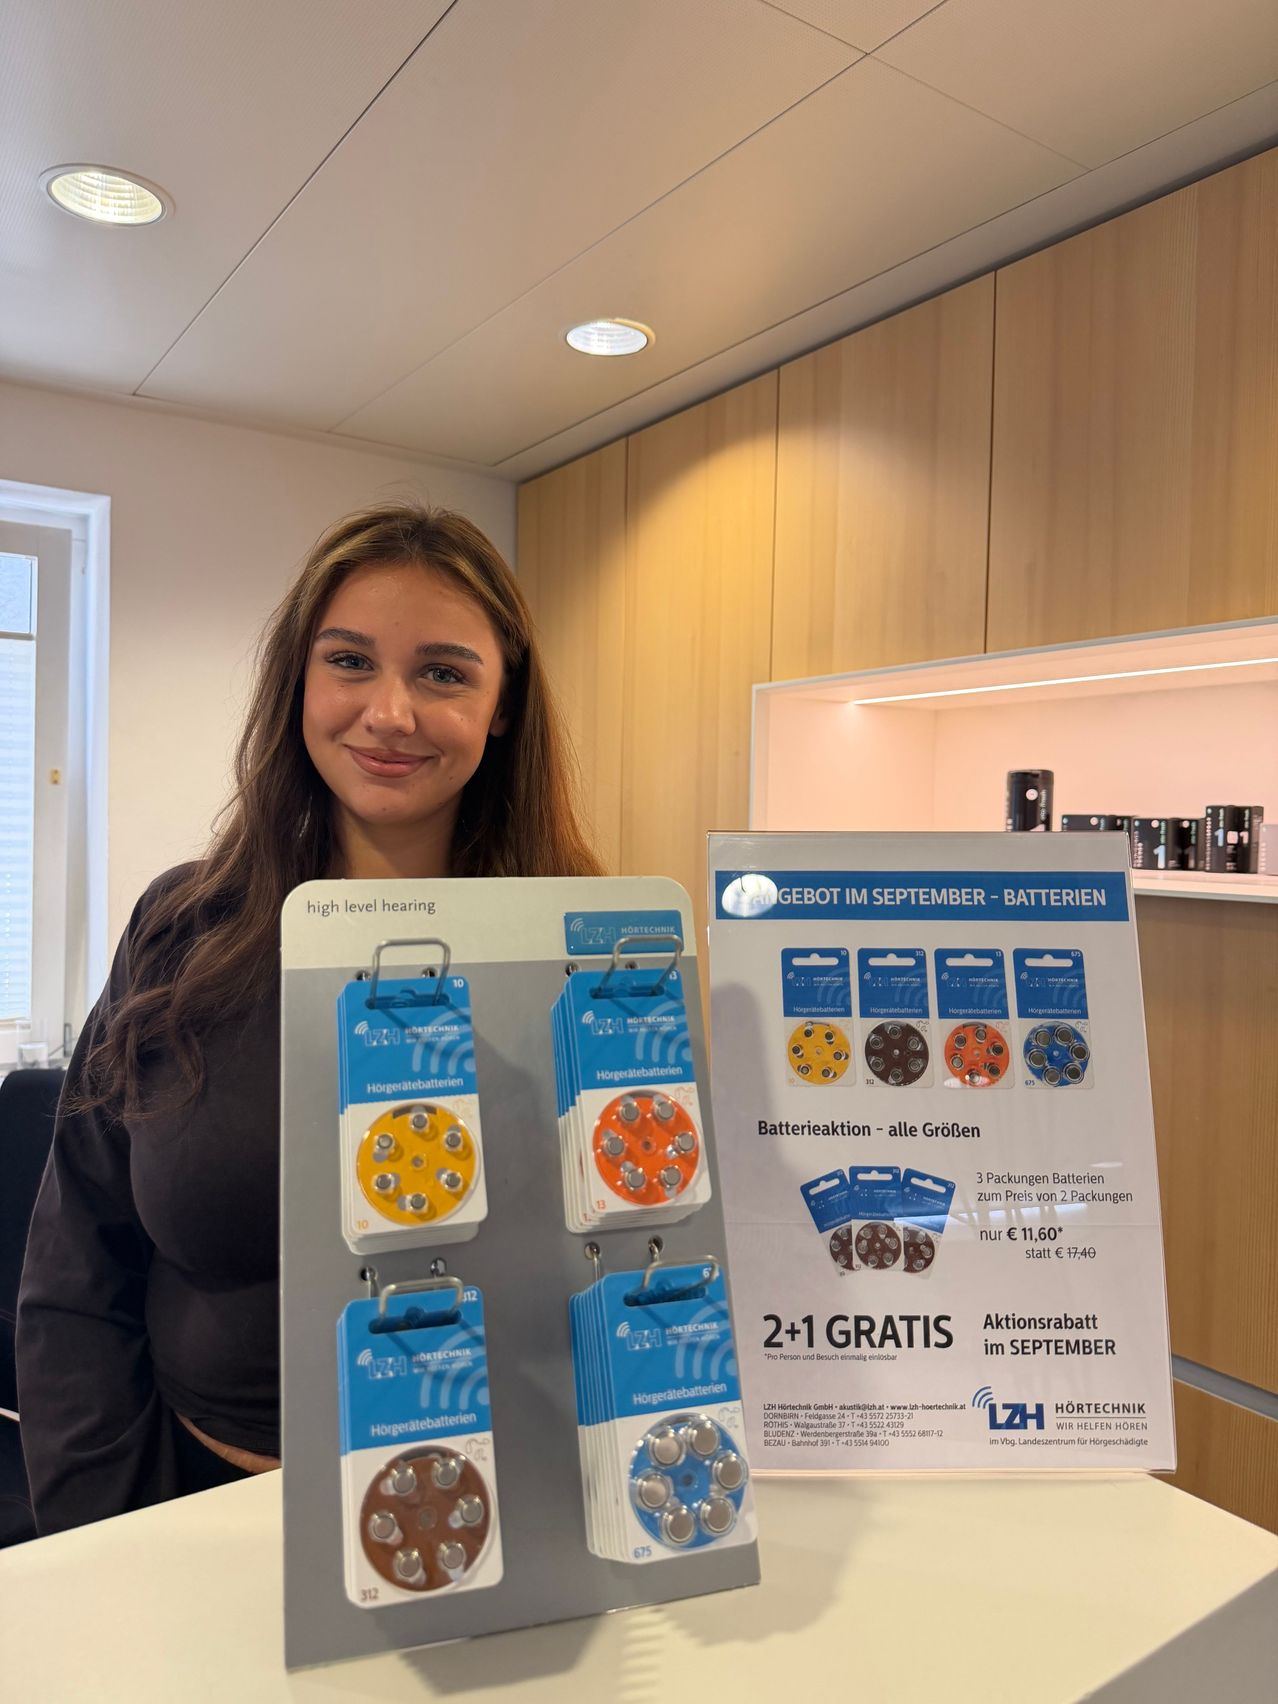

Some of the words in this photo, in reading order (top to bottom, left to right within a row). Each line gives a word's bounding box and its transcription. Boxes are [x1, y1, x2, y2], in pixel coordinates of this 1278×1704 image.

[846, 888, 868, 905] IM
[872, 888, 986, 906] SEPTEMBER
[1004, 888, 1106, 906] BATTERIEN
[307, 900, 339, 917] high
[345, 900, 377, 913] level
[382, 899, 436, 915] hearing
[453, 979, 464, 988] 10
[596, 1066, 683, 1081] Hörgerätebatterien
[367, 1077, 464, 1094] Hörgerätebatterien
[758, 1121, 871, 1137] Batterieaktion
[888, 1122, 917, 1138] alle
[922, 1123, 980, 1138] Größen
[976, 1172, 983, 1184] 3
[987, 1172, 1049, 1186] Packungen
[1053, 1172, 1104, 1184] Batterien
[977, 1192, 1001, 1201] zum
[1005, 1190, 1032, 1201] Preis
[1036, 1192, 1057, 1201] von
[1061, 1190, 1068, 1201] 2
[1070, 1190, 1133, 1204] Packungen
[596, 1200, 606, 1210] 13
[356, 1219, 368, 1230] 10
[980, 1229, 1003, 1241] nur
[1006, 1228, 1017, 1241] €
[1026, 1247, 1051, 1259] statt
[1055, 1247, 1064, 1259] €
[1067, 1247, 1096, 1260] 17,40
[983, 1313, 1098, 1330] Aktionsrabatt
[763, 1314, 814, 1348] 2+1
[826, 1314, 954, 1348] GRATIS
[984, 1340, 1004, 1355] im
[1010, 1339, 1116, 1355] SEPTEMBER
[840, 1353, 867, 1361] einmalig
[634, 1382, 727, 1405] Hörgerätebatterien
[989, 1403, 1044, 1430] LZH
[1056, 1401, 1146, 1414] HÖRTECHNIK
[371, 1412, 477, 1436] Hörgerätebatterien
[794, 1421, 837, 1430] Walgaustraße
[1116, 1422, 1148, 1430] HÖREN
[1000, 1438, 1017, 1446] Vbg.
[1090, 1438, 1148, 1447] Hörgeschädigte
[634, 1547, 652, 1558] 675
[360, 1588, 379, 1600] 312
